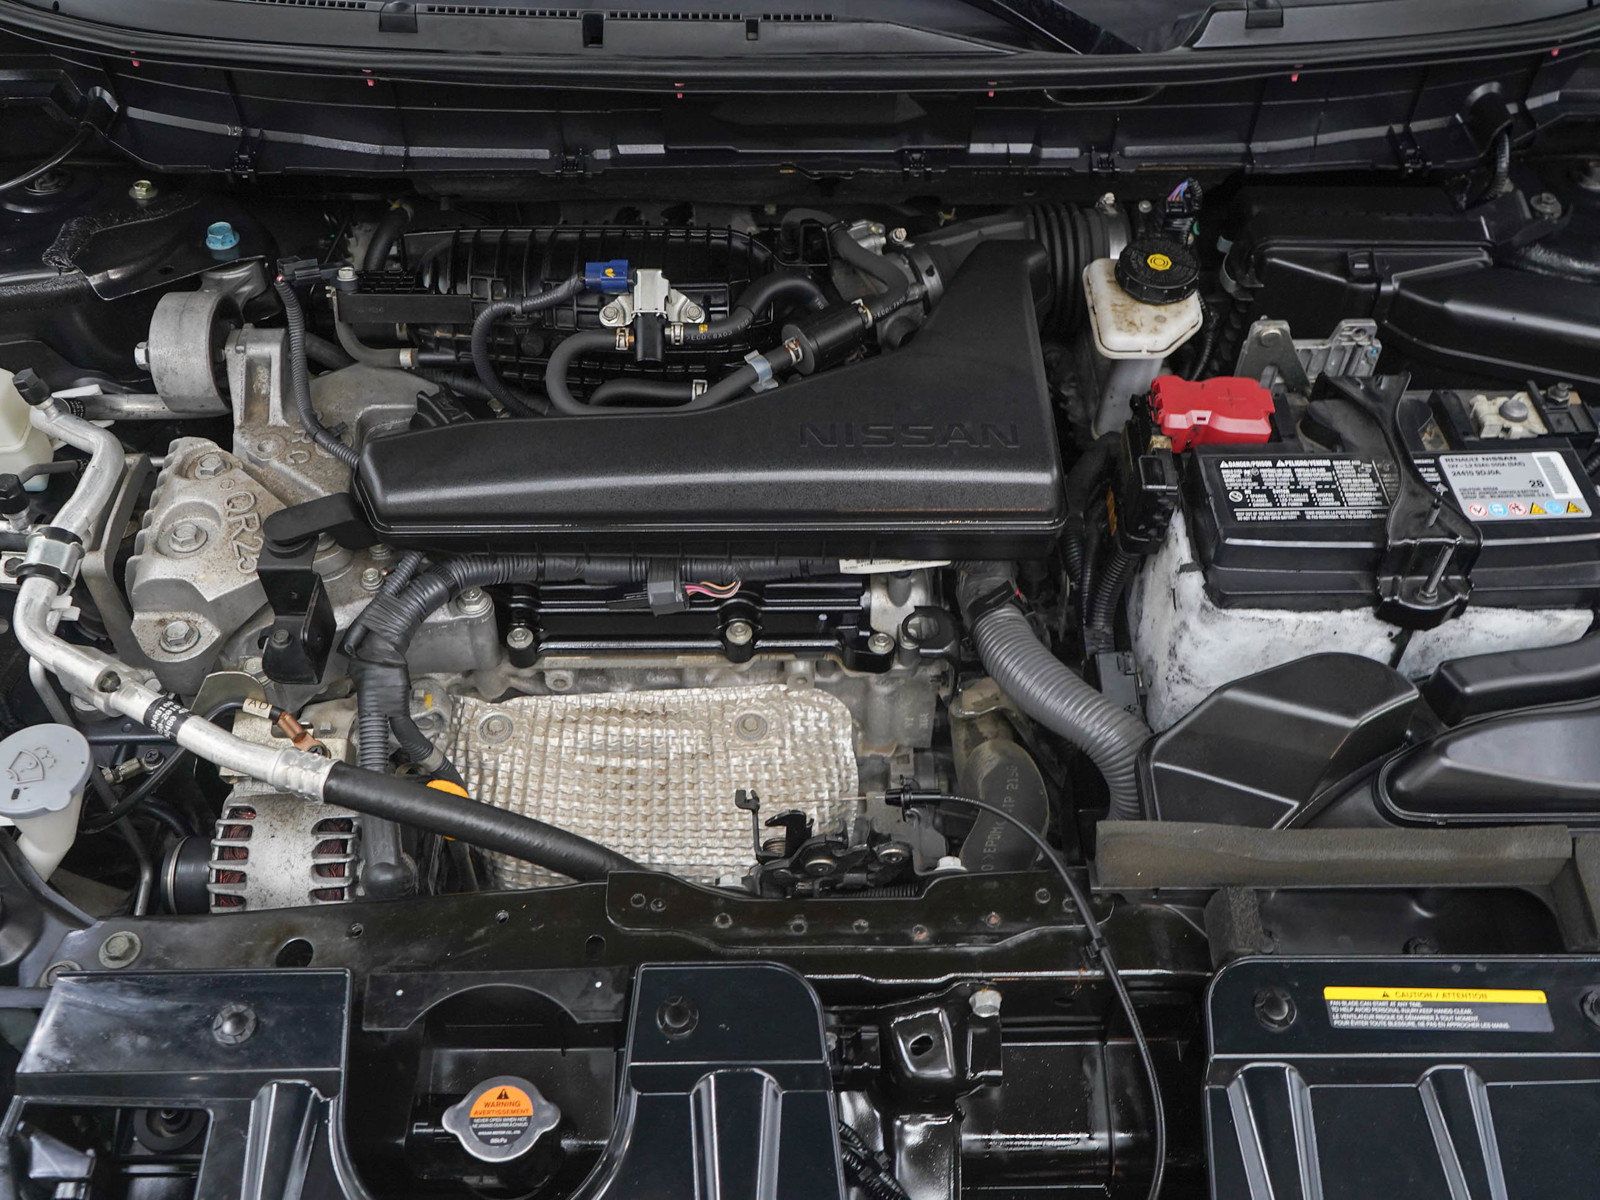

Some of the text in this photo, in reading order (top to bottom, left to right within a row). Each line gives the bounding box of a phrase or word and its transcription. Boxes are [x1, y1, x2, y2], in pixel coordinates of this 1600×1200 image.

[800, 422, 1020, 448] NISSAN
[1529, 480, 1544, 488] 28
[224, 491, 263, 574] QR25
[1442, 992, 1488, 1000] ATTENTION
[484, 1100, 521, 1108] WARNING
[474, 1108, 530, 1116] AVERTISSEMENT
